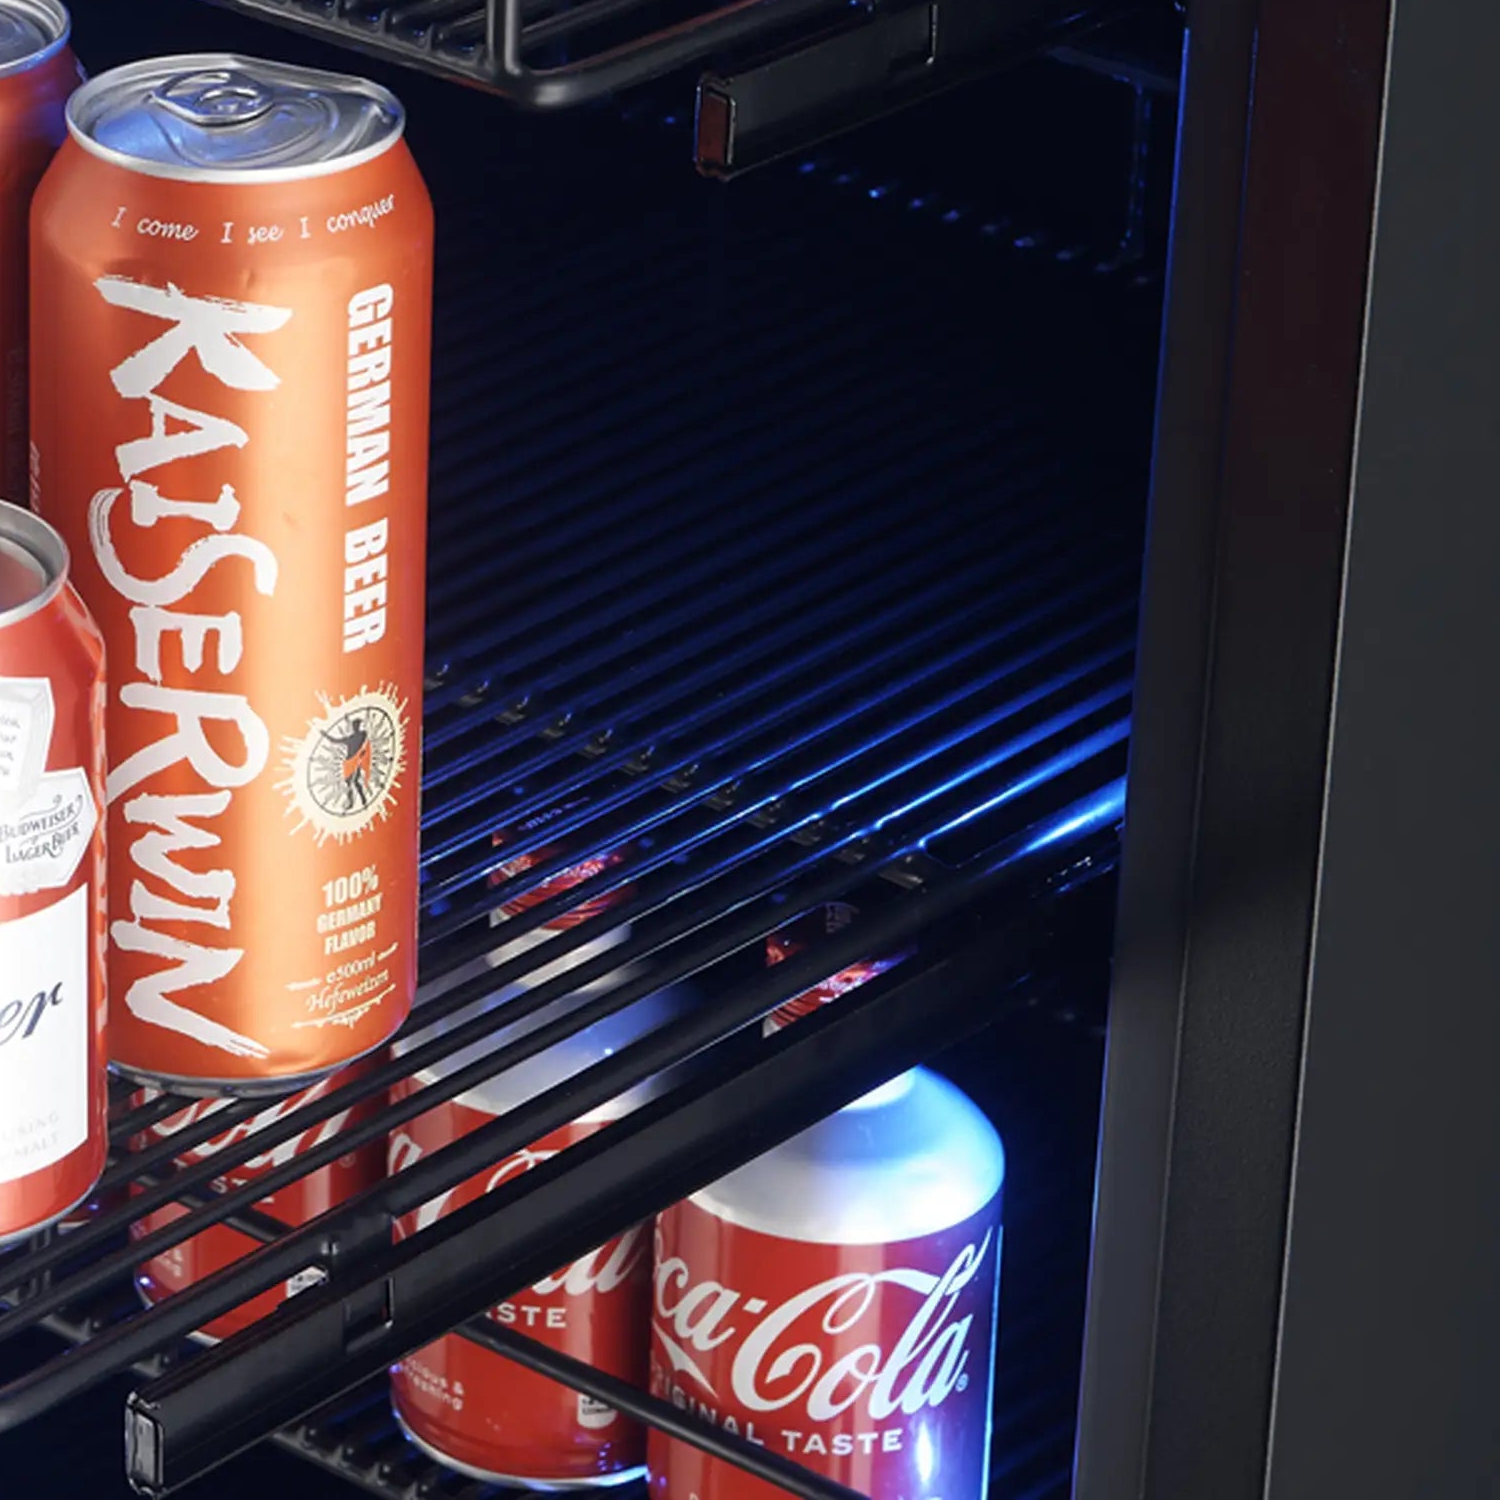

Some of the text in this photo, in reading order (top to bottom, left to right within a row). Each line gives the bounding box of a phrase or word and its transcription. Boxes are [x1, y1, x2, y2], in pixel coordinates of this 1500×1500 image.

[112, 193, 396, 244] I come I see I conquer
[343, 283, 394, 653] GERMAN BEER
[88, 274, 293, 1059] KAISERWIN
[5, 820, 82, 864] LAGER BEER
[322, 864, 380, 909] 100%
[316, 891, 383, 934] GERMANY
[324, 920, 376, 956] FLAVOR
[306, 966, 390, 1015] Hefeweizen
[486, 1303, 567, 1330] STE
[654, 1226, 992, 1422] ca-Cola
[780, 1428, 904, 1456] TASTE
